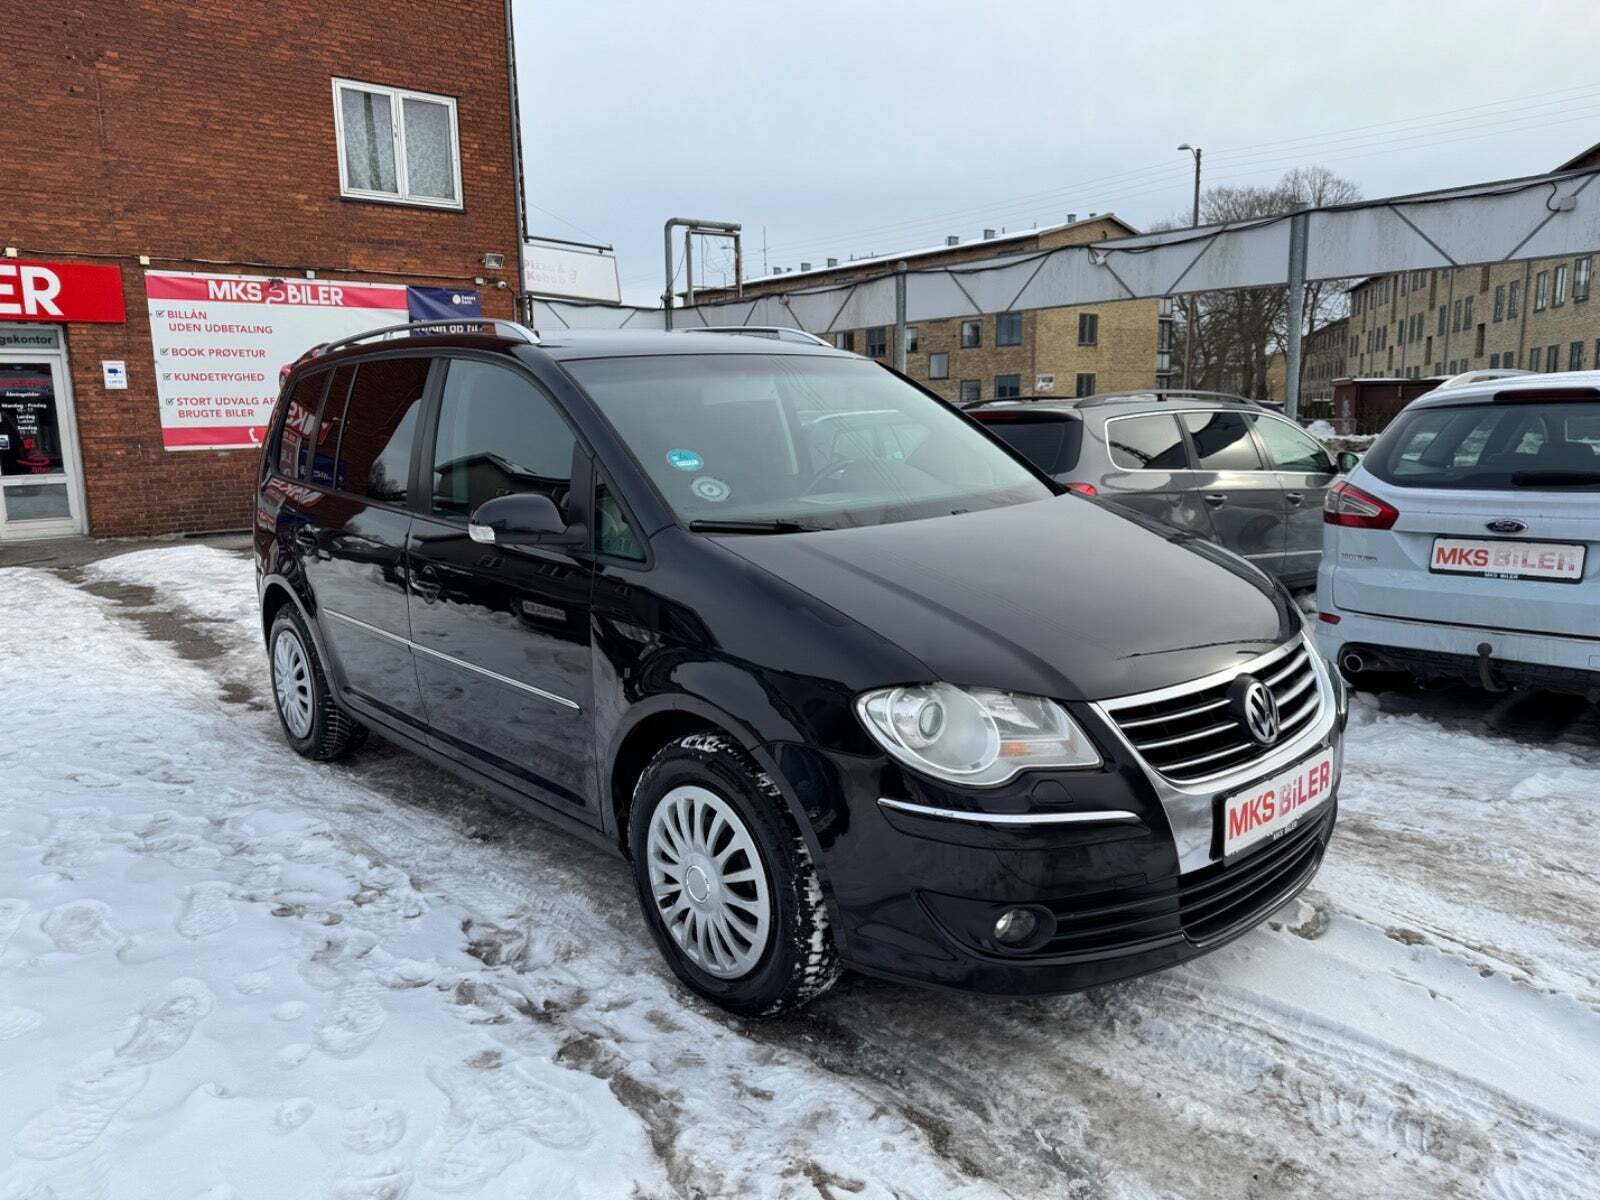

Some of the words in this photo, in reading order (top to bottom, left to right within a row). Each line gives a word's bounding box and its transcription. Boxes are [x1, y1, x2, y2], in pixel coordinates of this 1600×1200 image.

[208, 280, 262, 301] MKS
[287, 285, 344, 306] BILER
[167, 308, 207, 320] BILLÅN
[169, 322, 201, 333] UDEN
[205, 323, 273, 335] UDBETALING
[171, 347, 206, 358] BOOK
[208, 348, 266, 358] PRØVETUR
[174, 372, 265, 382] KUNDETRYGHED
[176, 397, 212, 406] STORT
[215, 396, 259, 406] UDVALG
[178, 409, 222, 418] BRUGTE
[225, 409, 255, 417] BILER
[1435, 547, 1489, 567] MKS
[1229, 790, 1275, 840] MKS
